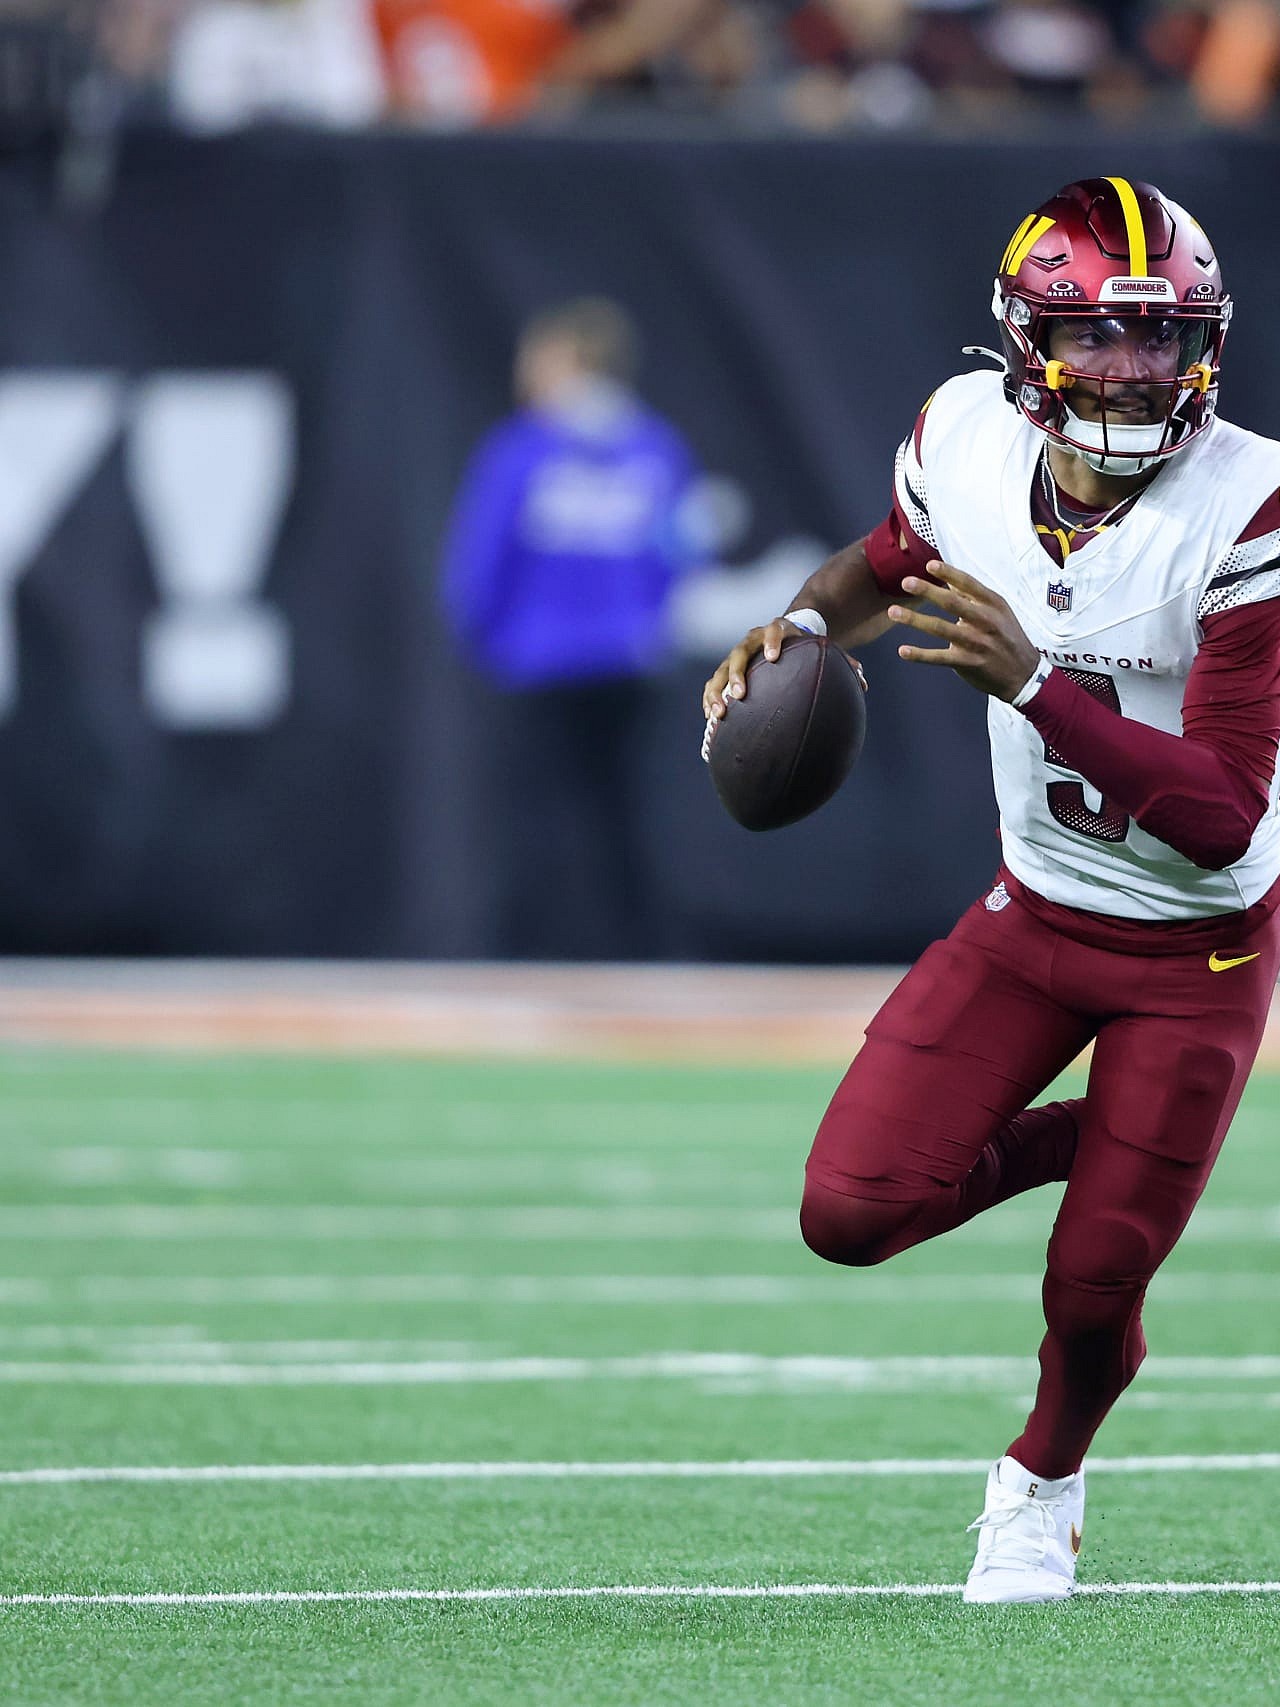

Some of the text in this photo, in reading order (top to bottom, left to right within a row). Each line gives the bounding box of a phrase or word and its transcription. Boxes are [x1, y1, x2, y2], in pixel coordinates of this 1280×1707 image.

[1111, 282, 1167, 292] COMMANDERS
[1050, 594, 1068, 608] NFL
[1036, 646, 1153, 669] HINGTON
[1027, 1482, 1038, 1498] 5
